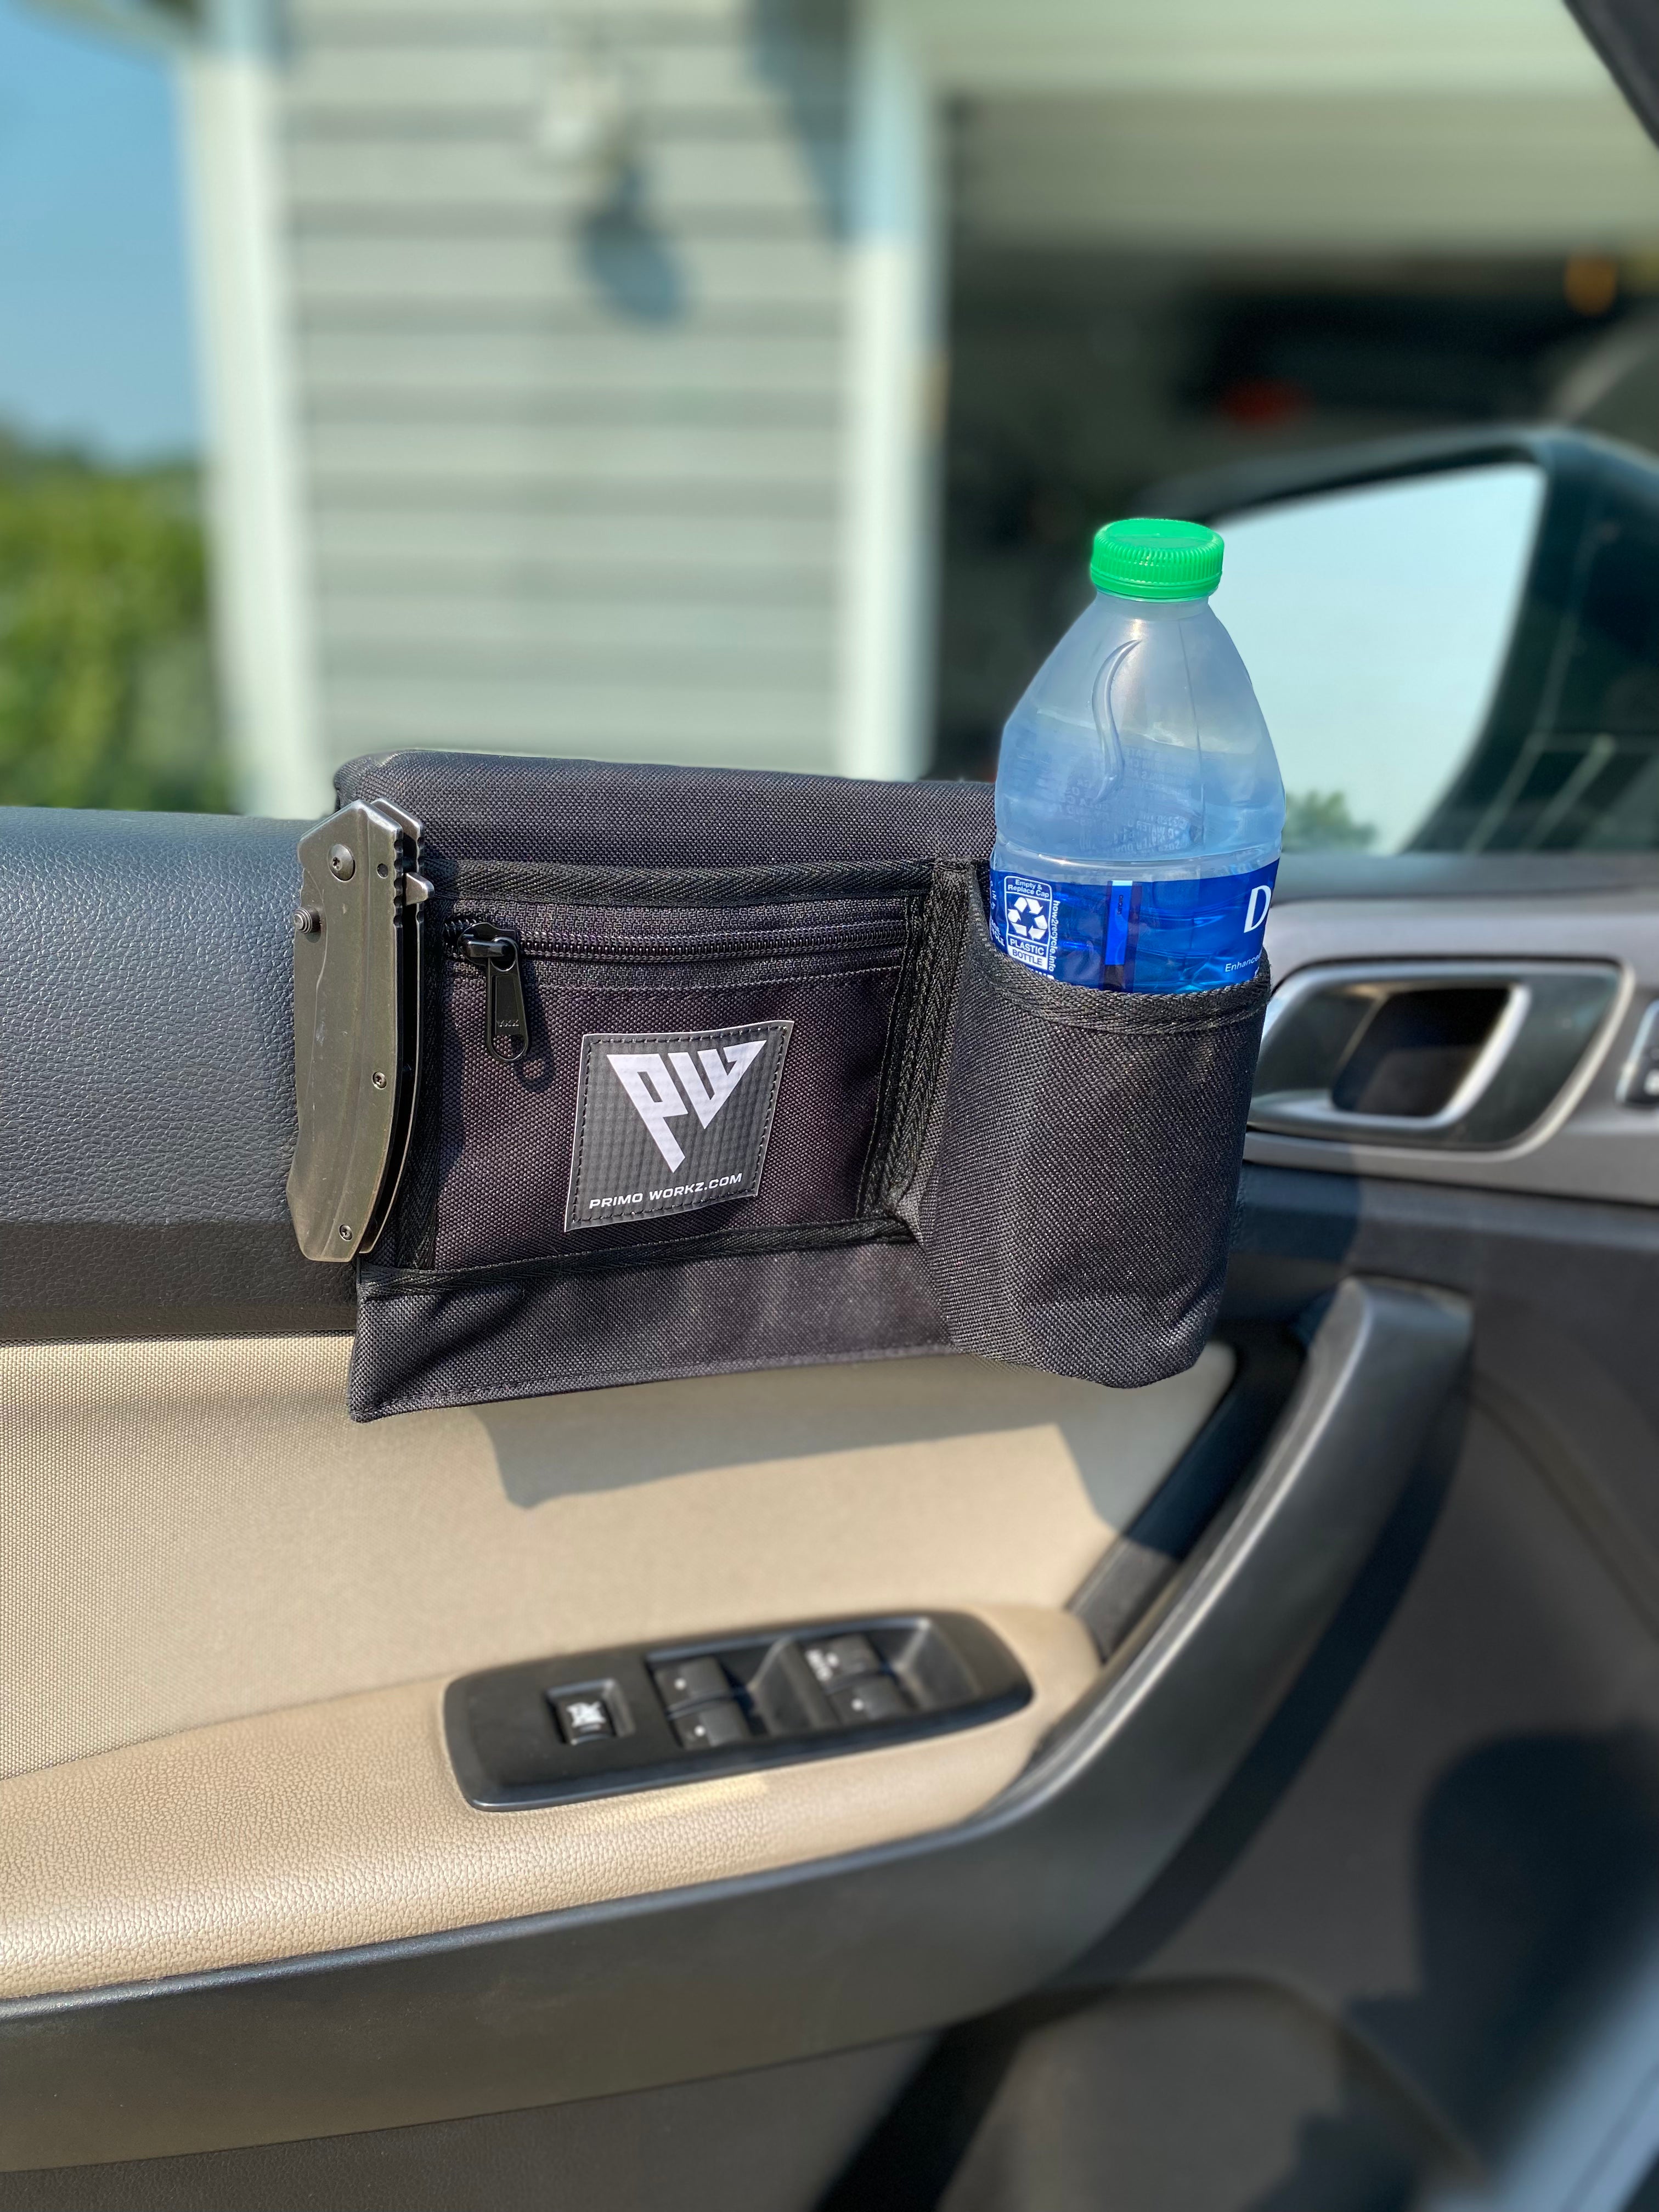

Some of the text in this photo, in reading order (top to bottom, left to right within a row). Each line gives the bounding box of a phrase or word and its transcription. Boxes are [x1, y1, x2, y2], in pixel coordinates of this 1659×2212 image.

[1008, 884, 1049, 899] Replace Cap
[1015, 879, 1036, 891] Empty
[1048, 899, 1061, 972] how2recycle.info
[1010, 938, 1045, 956] PLASTIC
[1012, 949, 1043, 966] BOTTLE
[1224, 955, 1261, 972] Enhance
[589, 1172, 743, 1209] PRIMO WORKZ.COM
